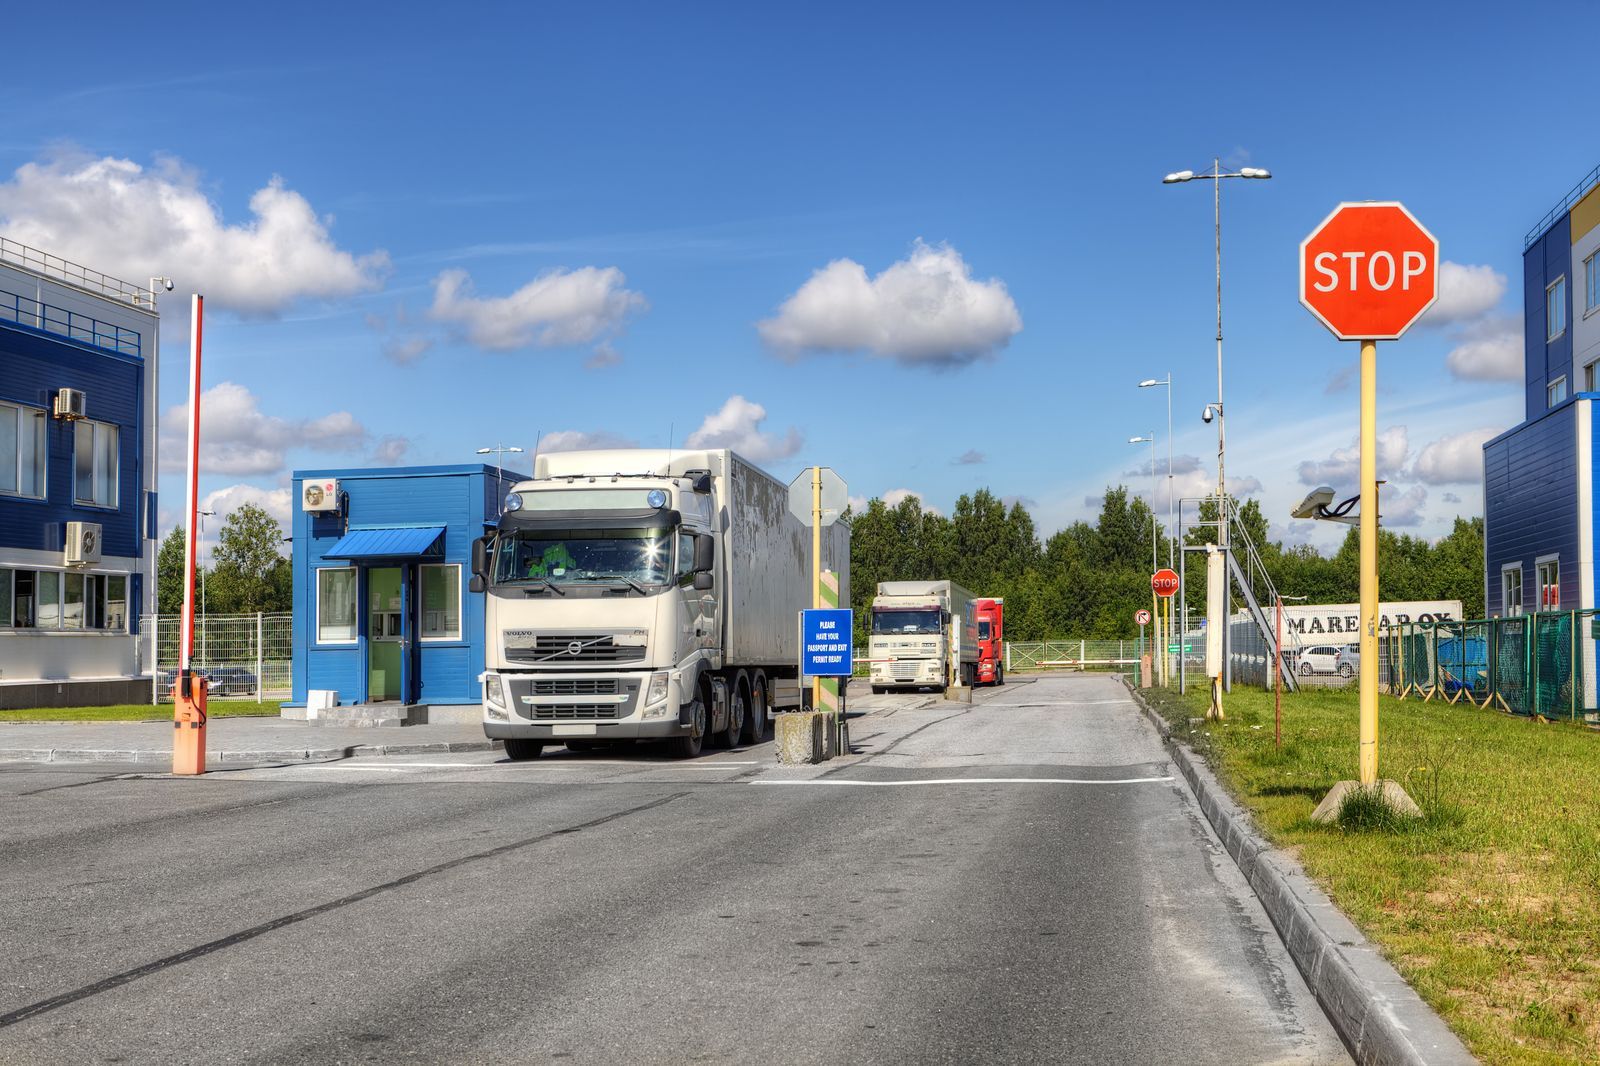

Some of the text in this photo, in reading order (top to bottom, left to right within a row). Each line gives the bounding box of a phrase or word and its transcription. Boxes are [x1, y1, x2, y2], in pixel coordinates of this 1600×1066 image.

[1313, 250, 1427, 292] STOP
[1153, 578, 1178, 588] STOP
[820, 621, 835, 629] PLEASE
[808, 644, 828, 652] PASSPORT
[829, 644, 837, 652] AND
